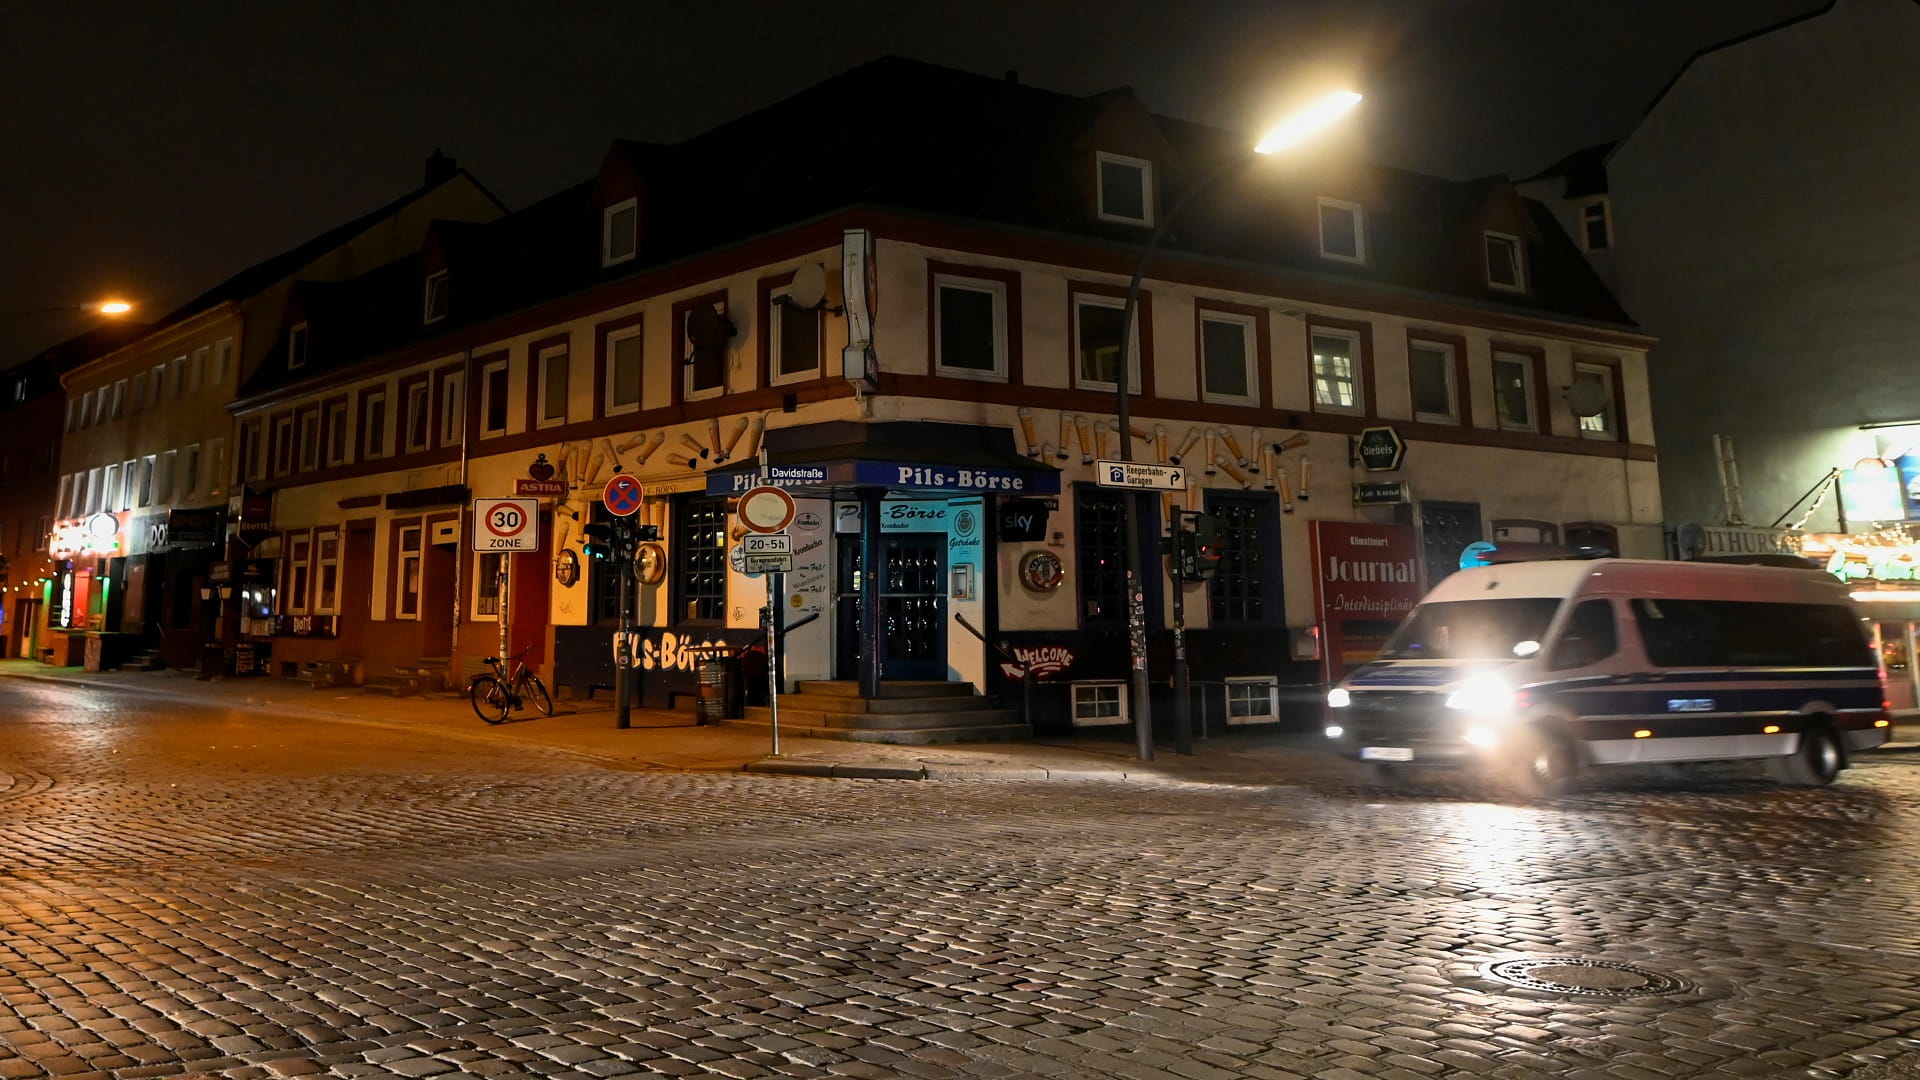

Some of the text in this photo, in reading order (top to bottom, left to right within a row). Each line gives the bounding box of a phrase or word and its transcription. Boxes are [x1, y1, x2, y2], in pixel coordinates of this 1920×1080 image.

[771, 467, 823, 479] Davidstraße
[898, 466, 1024, 490] Pils-Börse
[1126, 465, 1167, 477] Reeperbahn-
[520, 482, 563, 493] ASTRA
[1126, 475, 1153, 487] Garagen
[494, 511, 518, 528] 30
[1004, 511, 1033, 532] sky
[490, 538, 521, 548] ZONE
[1326, 556, 1416, 582] Journal
[1013, 648, 1074, 668] WELCOME
